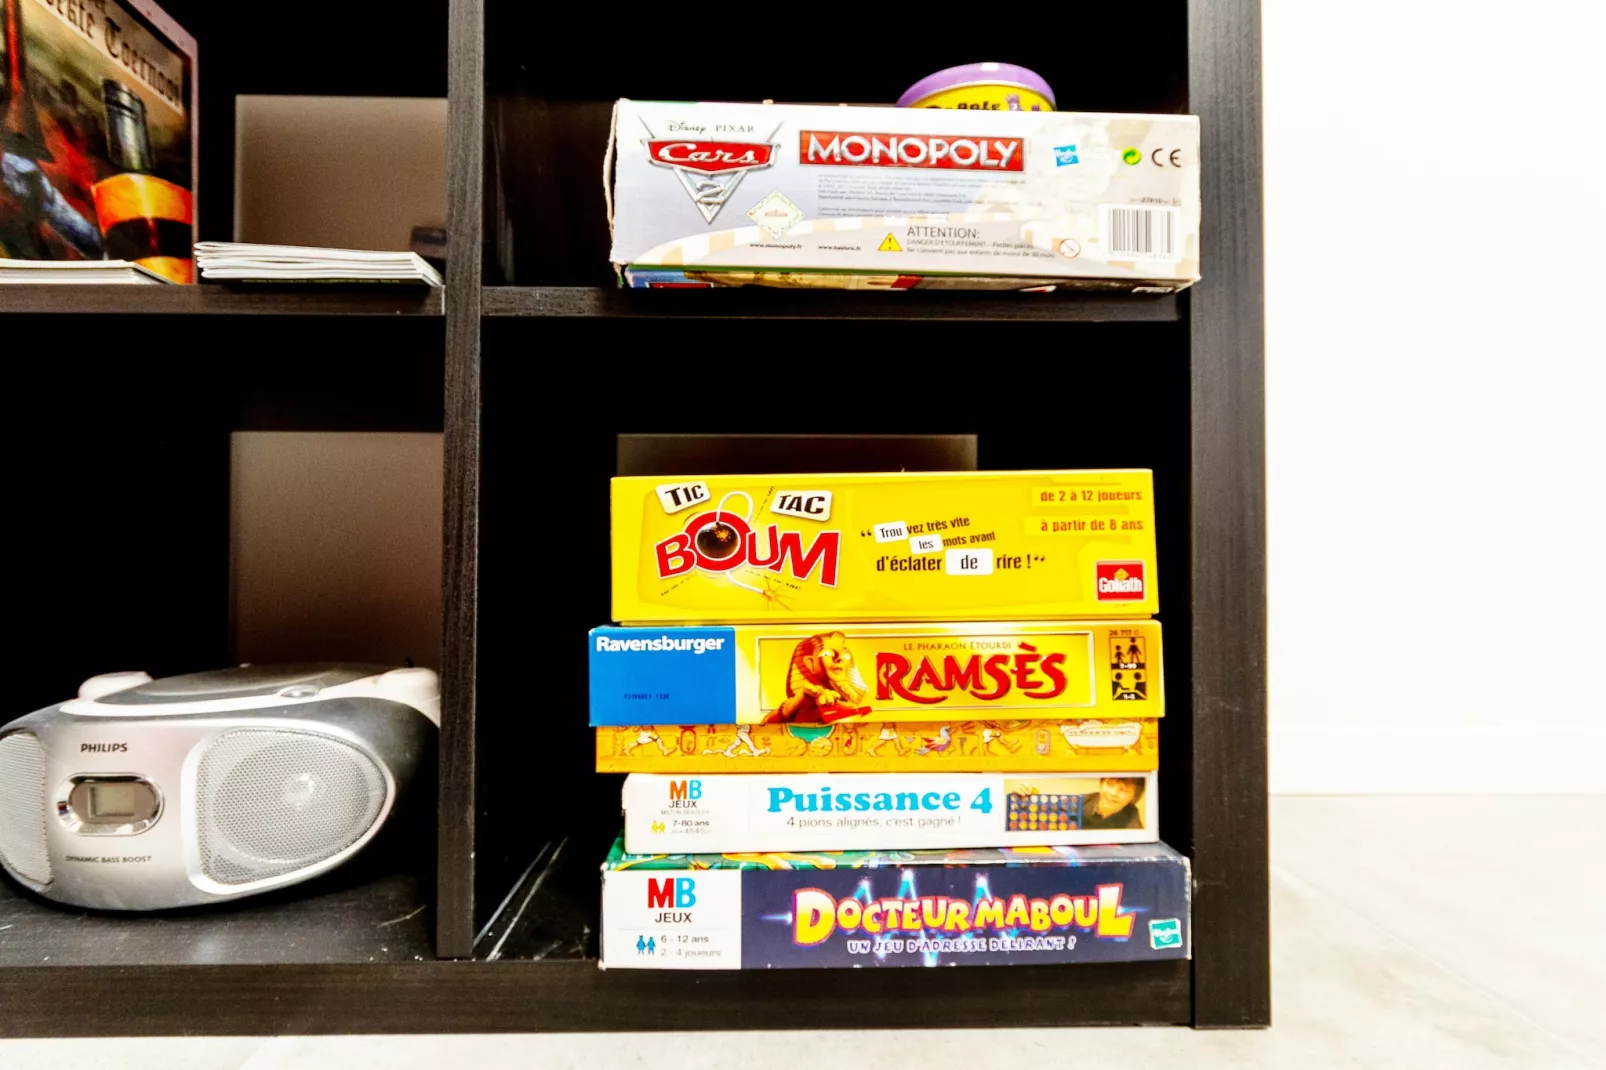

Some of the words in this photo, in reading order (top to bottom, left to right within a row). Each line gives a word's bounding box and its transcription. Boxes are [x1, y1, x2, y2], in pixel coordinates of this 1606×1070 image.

[668, 121, 707, 134] Disney
[716, 125, 755, 133] PIXAR
[658, 143, 759, 164] Cars
[807, 134, 1018, 168] MONOPOLY
[696, 180, 725, 206] 2
[907, 226, 980, 239] ATTENTION:
[665, 484, 704, 507] TIC
[1040, 490, 1055, 502] de
[1058, 490, 1067, 502] 2
[1070, 489, 1078, 502] à
[1081, 490, 1094, 502] 12
[1097, 489, 1143, 503] joueurs
[778, 494, 826, 515] TAC
[926, 518, 948, 533] très
[950, 516, 971, 529] vite
[1040, 518, 1049, 532] à
[1052, 518, 1087, 534] partir
[1090, 519, 1104, 531] de
[1109, 519, 1117, 531] 8
[1121, 520, 1144, 531] ans
[655, 510, 841, 588] BOUM
[918, 539, 934, 551] les
[942, 535, 967, 548] mots
[969, 531, 996, 545] avant
[876, 555, 942, 572] d'éclater
[960, 554, 979, 570] de
[996, 554, 1022, 570] rire
[1098, 577, 1143, 594] Goliath
[596, 636, 725, 654] Ravensburger
[903, 643, 915, 651] LE
[917, 642, 967, 651] PHARAON
[969, 640, 1012, 650] ÉTOURDI
[875, 641, 1068, 705] RAMSÈS
[80, 743, 128, 753] PHILIPS
[669, 779, 703, 800] MB
[668, 800, 698, 809] JEUX
[766, 785, 961, 813] Puissance
[970, 787, 993, 815] 4
[673, 819, 693, 828] 7-80
[786, 816, 796, 828] 4
[798, 816, 832, 829] pions
[836, 815, 882, 829] alignés,
[885, 815, 914, 827] c'est
[917, 815, 954, 830] gagné
[648, 878, 696, 908] MB
[655, 912, 692, 923] JEUX
[792, 887, 971, 945] DOCTEUR
[974, 883, 1136, 938] MABOUL
[661, 935, 667, 943] 6
[678, 935, 690, 943] 12
[847, 939, 869, 954] UN
[873, 939, 904, 954] JEU
[907, 939, 987, 953] D'ADRESSE
[661, 949, 667, 957] 2
[684, 949, 721, 958] joueurs
